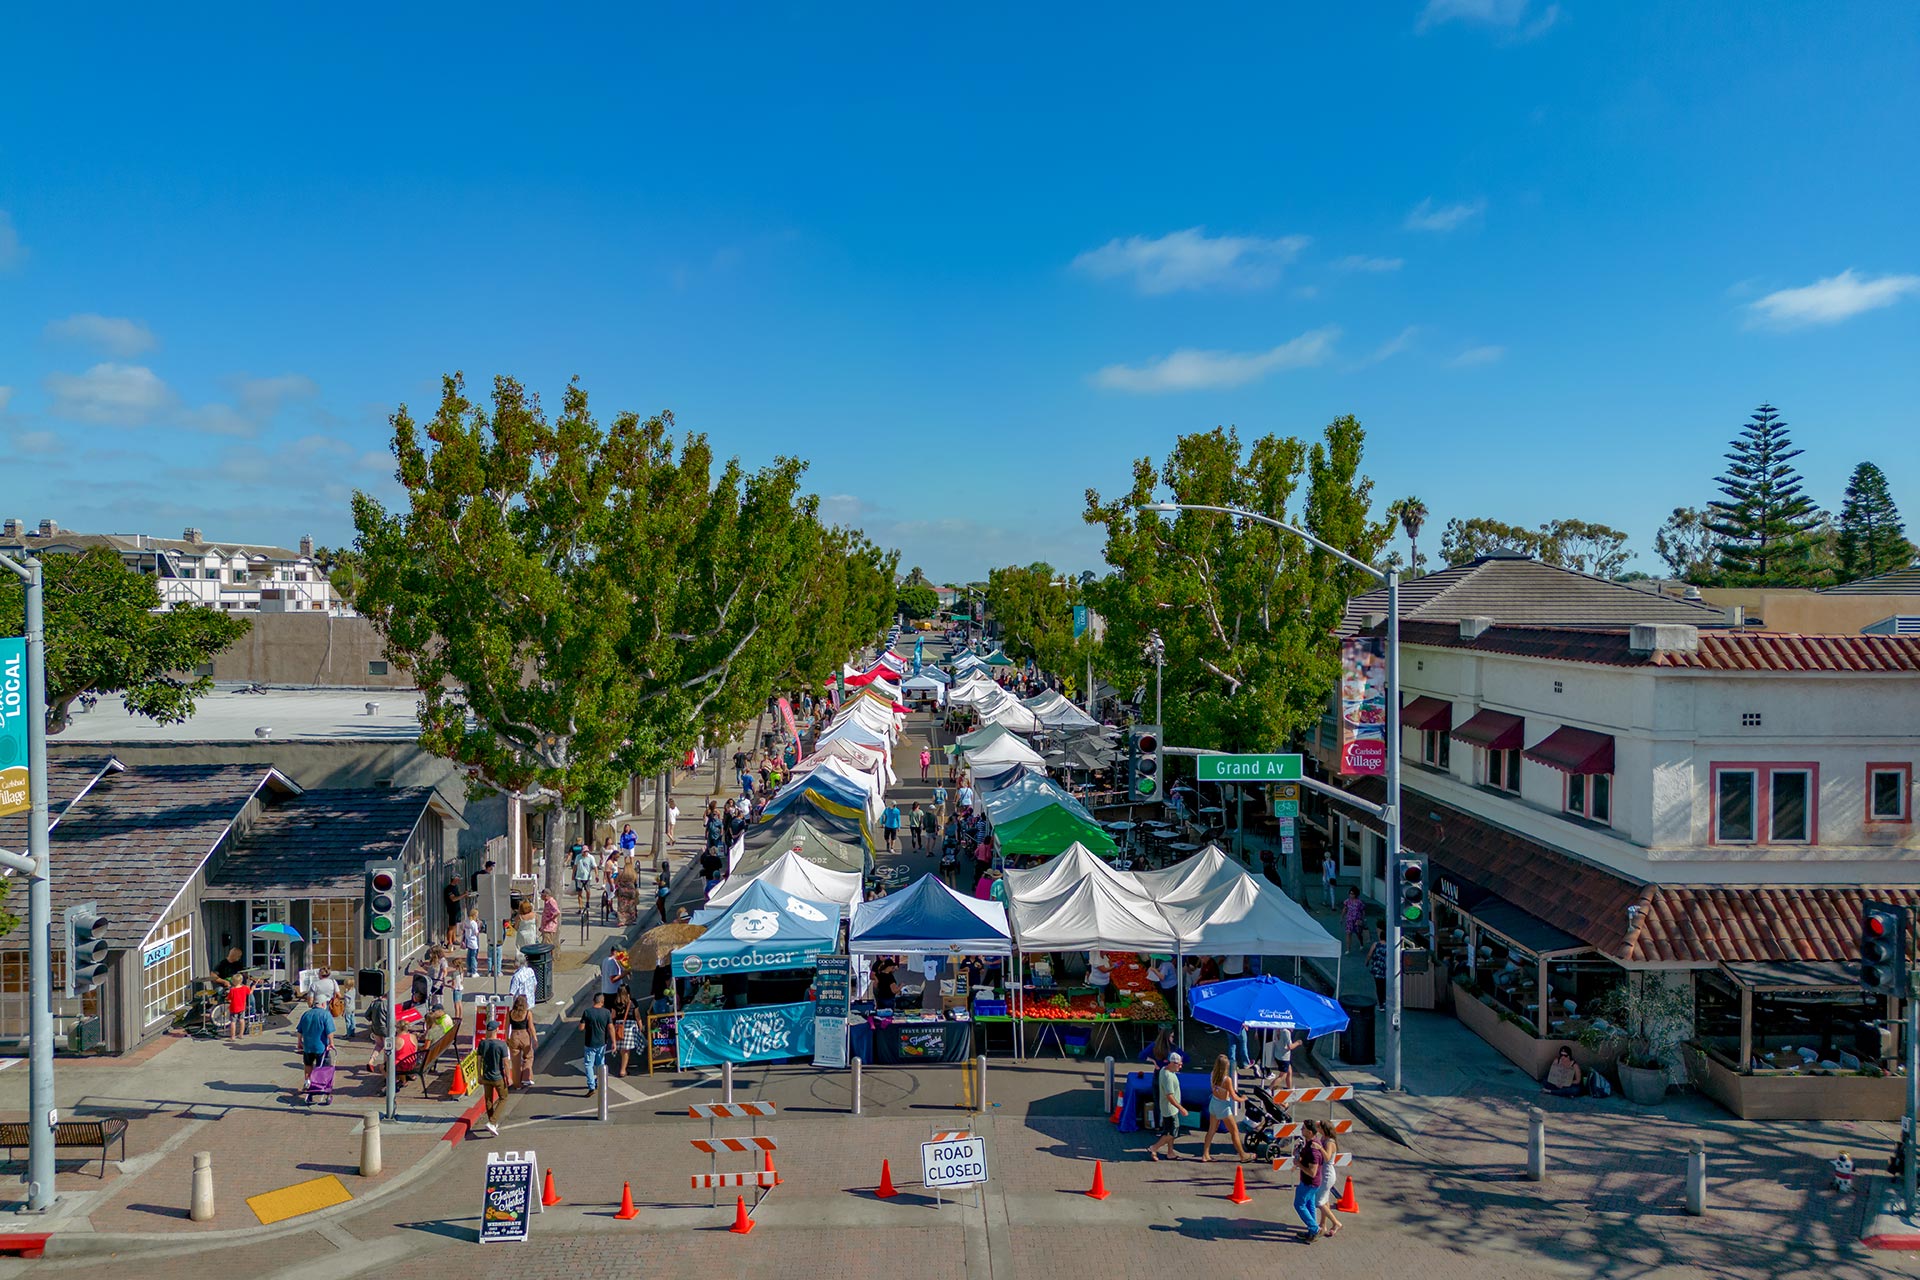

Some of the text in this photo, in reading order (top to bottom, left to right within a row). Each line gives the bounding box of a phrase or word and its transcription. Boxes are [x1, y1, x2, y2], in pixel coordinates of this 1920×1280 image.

[5, 653, 20, 717] LOCAL
[1216, 760, 1284, 774] Grand Av
[1345, 755, 1382, 770] Village
[2, 778, 26, 789] Carlsbad
[0, 790, 26, 805] illage
[147, 946, 169, 963] ART
[708, 951, 792, 969] cocobear
[1260, 1011, 1293, 1019] Carlsbad
[729, 1018, 785, 1045] ISLAND
[743, 1031, 791, 1058] VIBES
[465, 1061, 476, 1077] STEP
[934, 1145, 973, 1161] ROAD
[489, 1165, 528, 1175] STATE
[929, 1163, 982, 1180] CLOSED
[489, 1174, 527, 1183] STREET
[498, 1194, 525, 1212] Market
